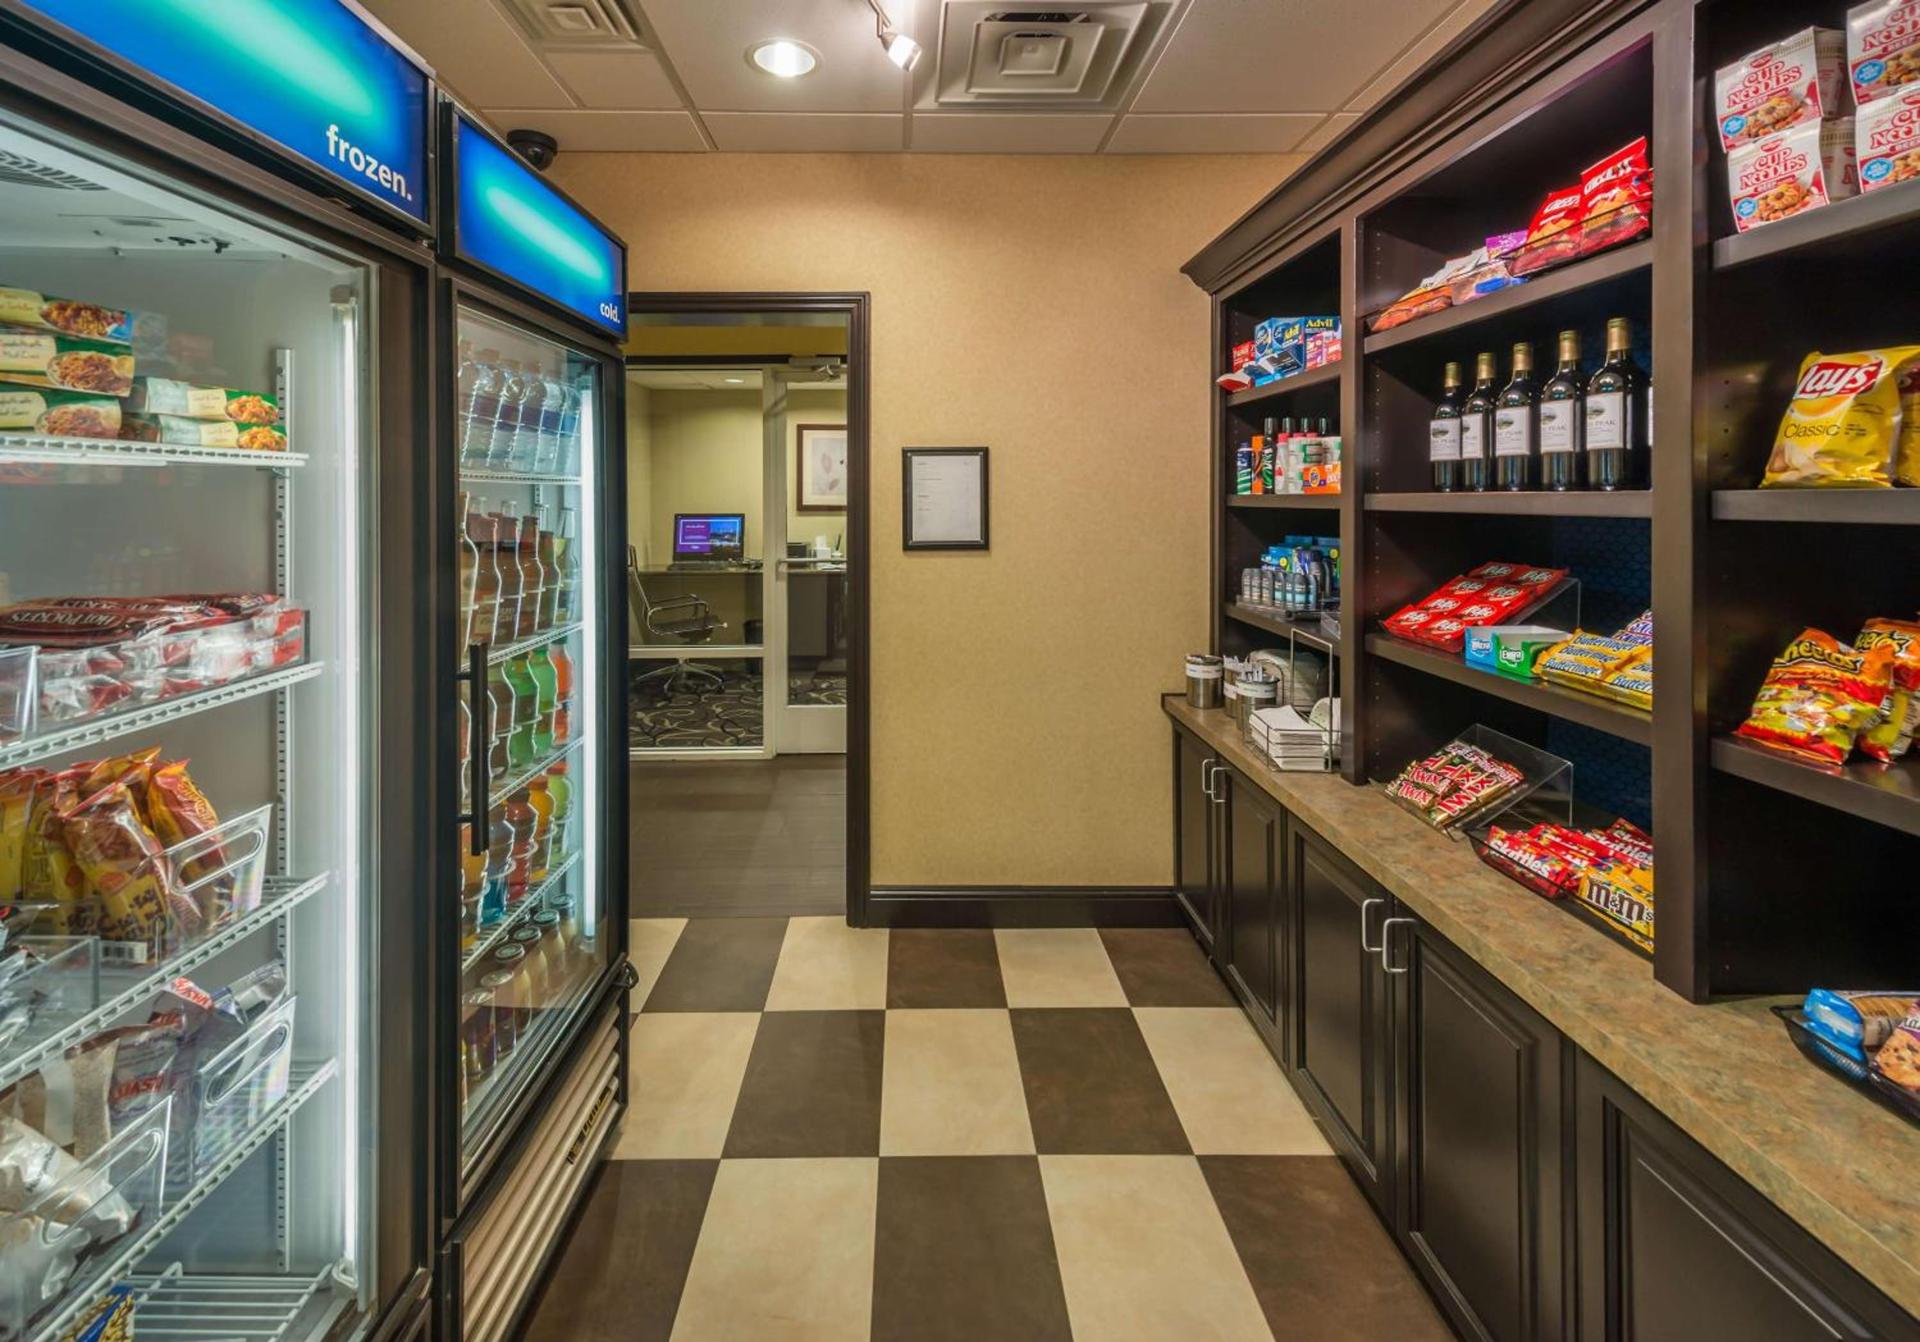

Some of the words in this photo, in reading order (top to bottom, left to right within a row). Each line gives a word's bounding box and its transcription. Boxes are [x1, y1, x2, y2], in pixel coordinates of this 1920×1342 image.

[1726, 66, 1802, 109] NOODLES
[1743, 60, 1786, 88] CUP
[326, 124, 412, 201] frozen.
[1740, 153, 1808, 190] NOODLES
[1755, 147, 1793, 170] CUP
[600, 303, 621, 324] cold.
[1305, 319, 1334, 329] Advil
[1783, 423, 1842, 439] Classic
[1774, 640, 1863, 673] heetos
[1488, 838, 1552, 879] Skittles
